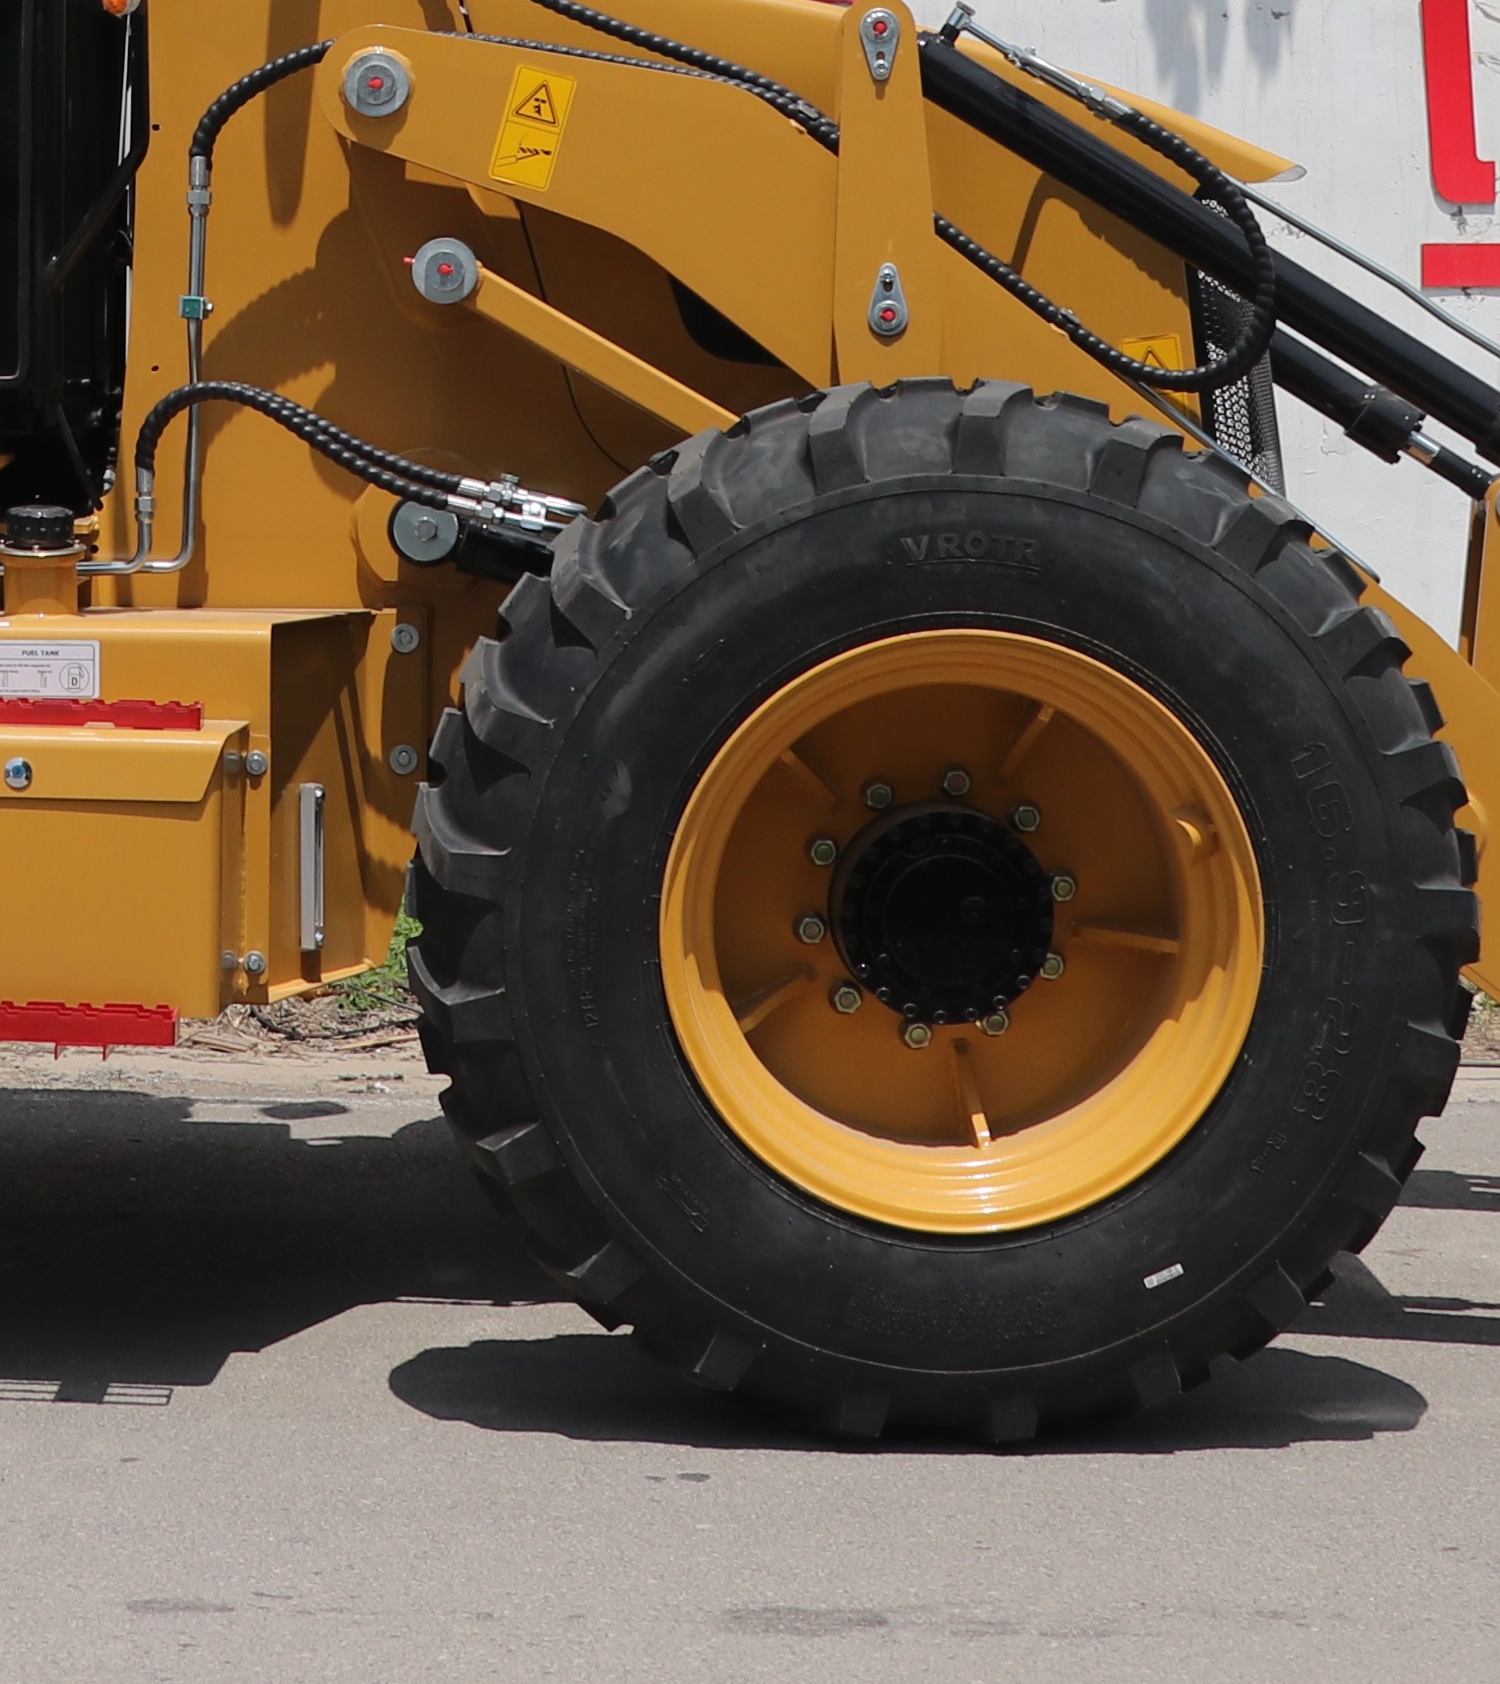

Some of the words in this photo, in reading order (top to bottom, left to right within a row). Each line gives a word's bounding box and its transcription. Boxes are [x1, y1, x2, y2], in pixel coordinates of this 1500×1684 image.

[21, 649, 39, 657] FUEL
[40, 649, 60, 657] TANK
[71, 677, 78, 687] D
[1289, 741, 1370, 1121] 16.9-28
